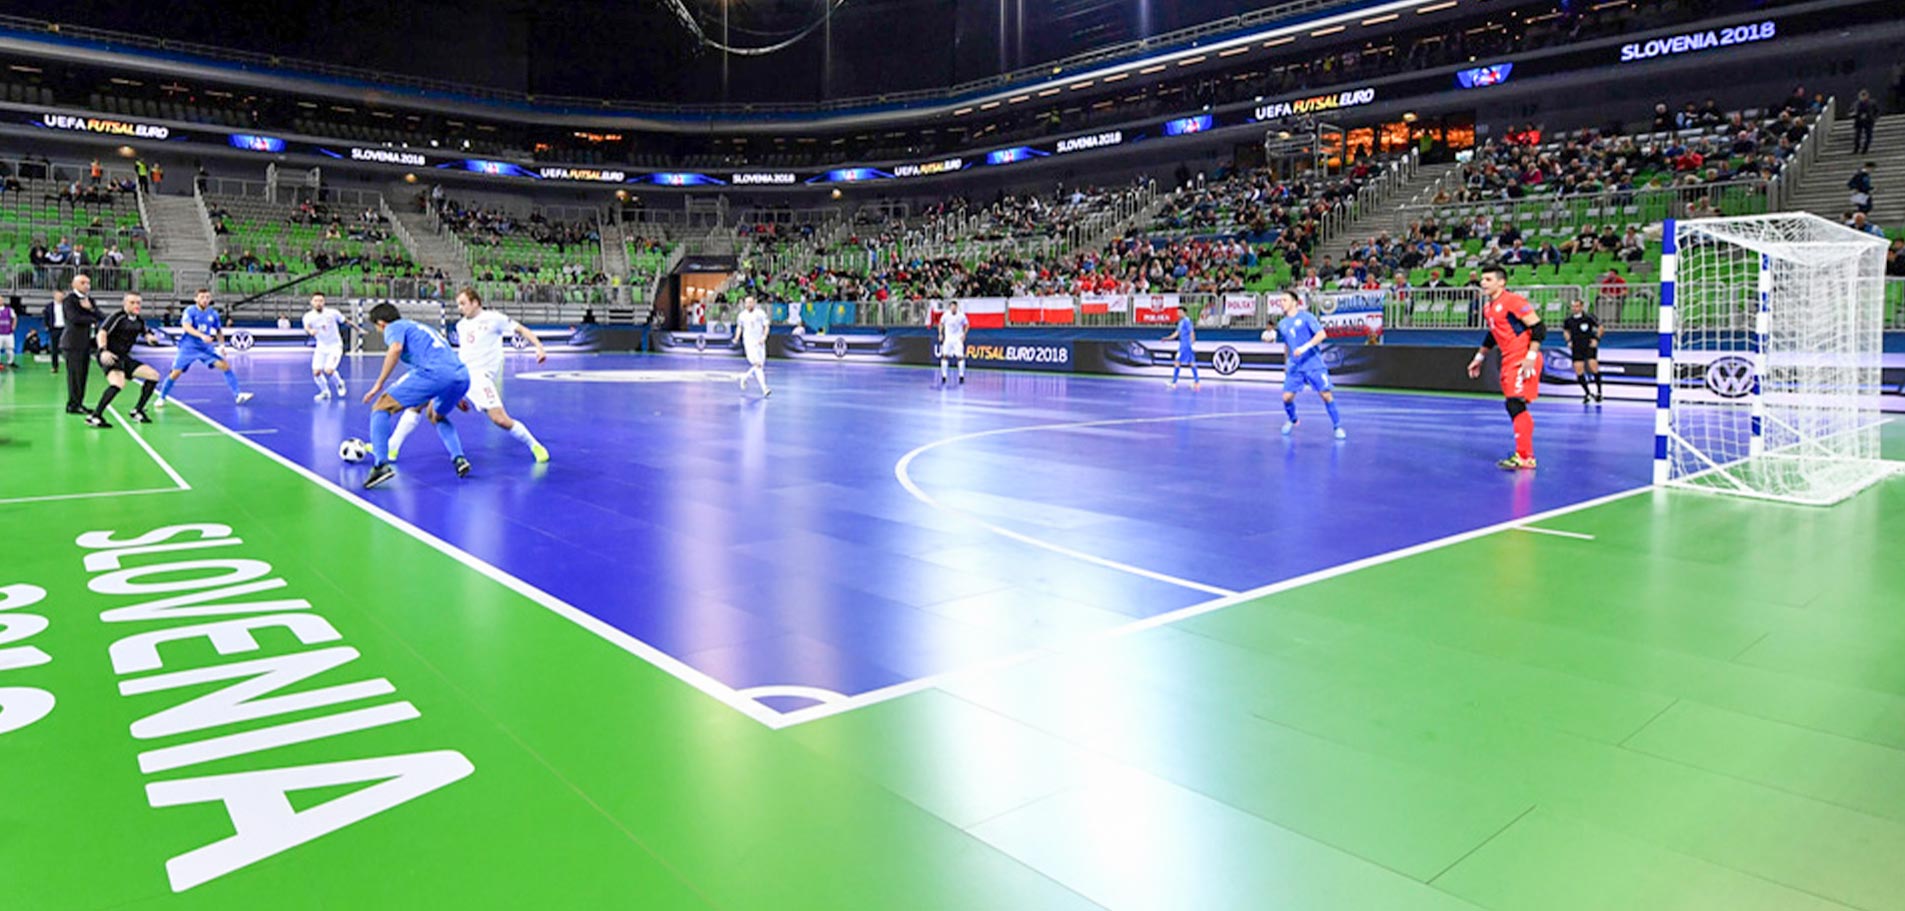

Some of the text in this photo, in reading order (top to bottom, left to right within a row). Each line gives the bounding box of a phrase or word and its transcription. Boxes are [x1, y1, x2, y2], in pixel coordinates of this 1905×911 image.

[1620, 21, 1776, 61] SLOVENIA 2018
[1255, 88, 1375, 120] UEFA FUTSAL EURO
[44, 114, 169, 139] UEFA FUTSAL EURO
[1056, 130, 1122, 153] SLOVENIA 2018
[351, 147, 426, 166] SLOVENIA 2018
[540, 167, 625, 182] UEFA FUTSAL EURO
[732, 172, 796, 184] SLOVENIA 2018
[894, 165, 920, 177] UEFA
[965, 344, 1006, 360] FUTSAL
[1006, 346, 1035, 361] EURO
[1034, 347, 1068, 363] 2018
[75, 522, 476, 893] SLOVENIA
